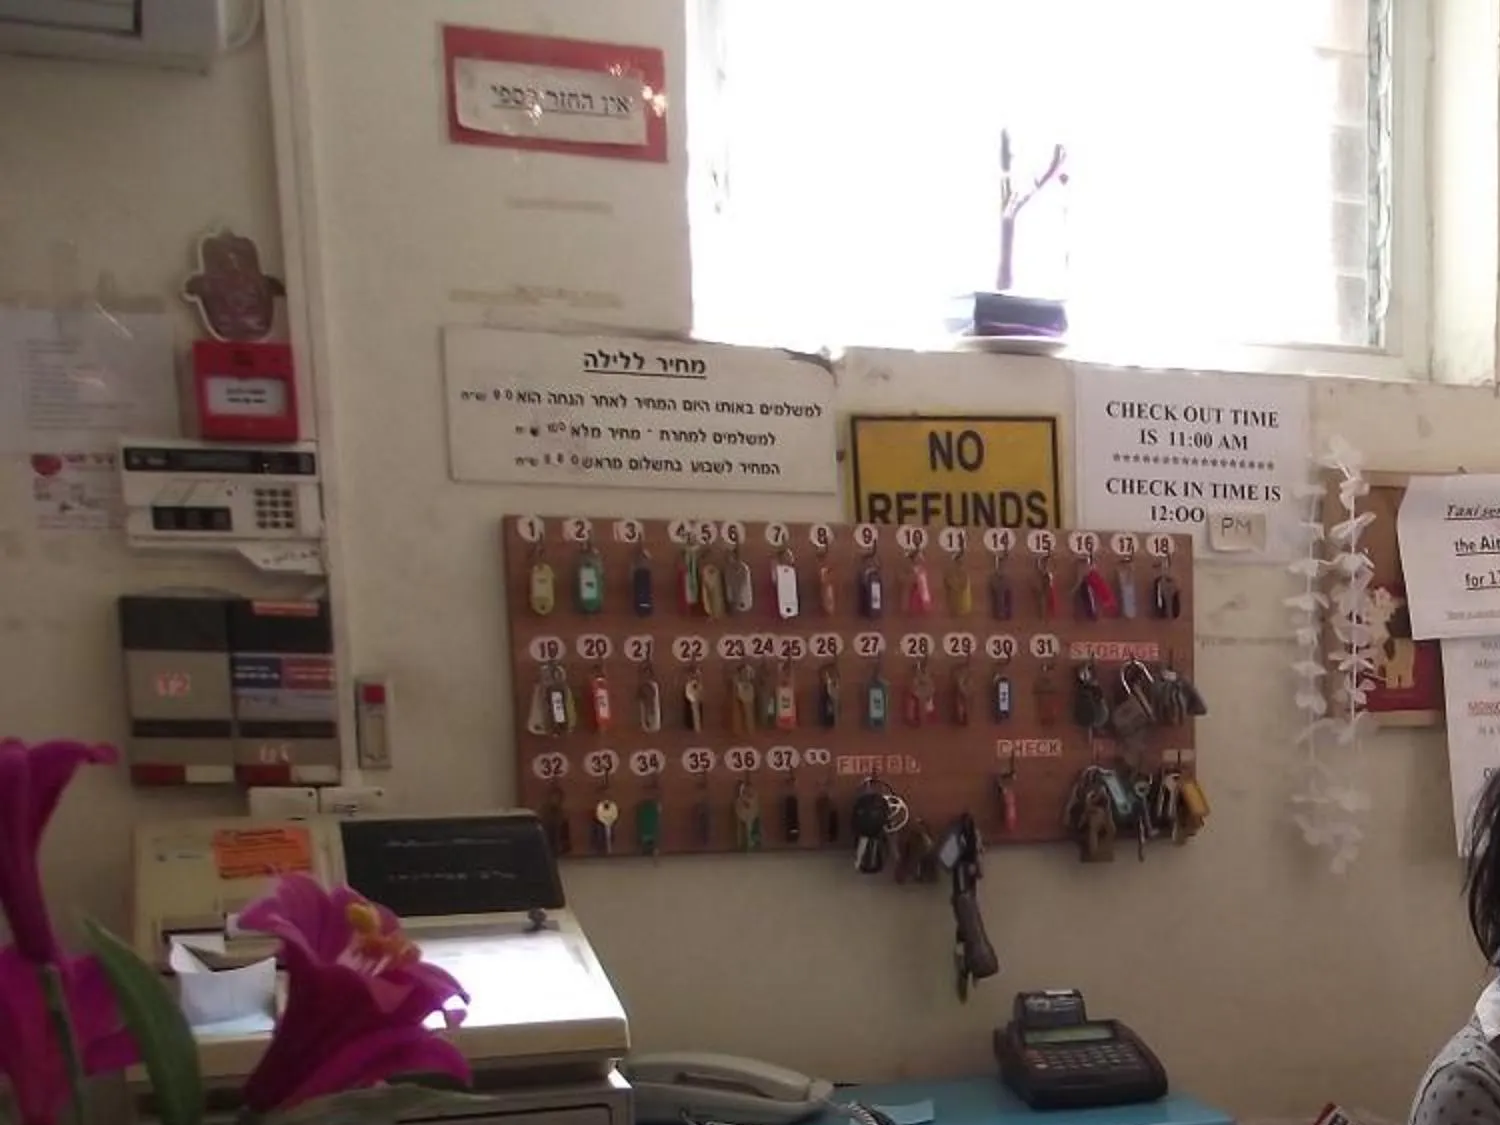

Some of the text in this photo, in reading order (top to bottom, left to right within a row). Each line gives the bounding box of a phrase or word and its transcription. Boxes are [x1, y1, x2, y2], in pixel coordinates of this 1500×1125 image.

[546, 88, 594, 110] החזר
[602, 94, 633, 116] אין
[583, 350, 706, 375] מחיר ללילה
[590, 394, 627, 409] לאחר
[634, 396, 677, 411] המחיר
[682, 399, 711, 413] היום
[715, 401, 754, 415] באותו
[759, 403, 822, 418] למשלמים
[1106, 399, 1280, 429] CHECK OUT TIME
[570, 423, 602, 439] מלא
[608, 426, 641, 441] מחיר
[713, 431, 776, 446] למשלמים
[1138, 428, 1249, 451] IS 11:00 AM
[928, 429, 985, 472] NO
[739, 461, 781, 475] המחיר
[1105, 477, 1282, 502] CHECK IN TIME IS
[1446, 504, 1478, 518] Taxi
[575, 521, 587, 540] 2
[625, 522, 638, 541] 3
[701, 523, 713, 541] 5
[1220, 514, 1252, 536] PM
[816, 527, 828, 545] 8
[904, 529, 922, 547] 10
[946, 531, 963, 549] 11
[991, 532, 1009, 550] 14
[1034, 534, 1051, 552] 15
[1075, 535, 1093, 552] 16
[1120, 536, 1134, 552] 17
[1153, 537, 1168, 553] 18
[1454, 539, 1477, 553] the
[1465, 572, 1485, 587] for
[584, 637, 608, 657] 20
[632, 640, 652, 658] 21
[680, 640, 703, 658] 22
[725, 640, 745, 658] 23
[752, 637, 774, 654] 24
[781, 640, 801, 658] 25
[860, 636, 880, 653] 27
[991, 638, 1013, 657] 30
[1036, 638, 1053, 656] 31
[540, 758, 564, 777] 32
[591, 755, 613, 773] 33
[636, 753, 659, 772] 34
[688, 752, 711, 770] 35
[731, 751, 755, 769] 36
[772, 750, 793, 768] 37
